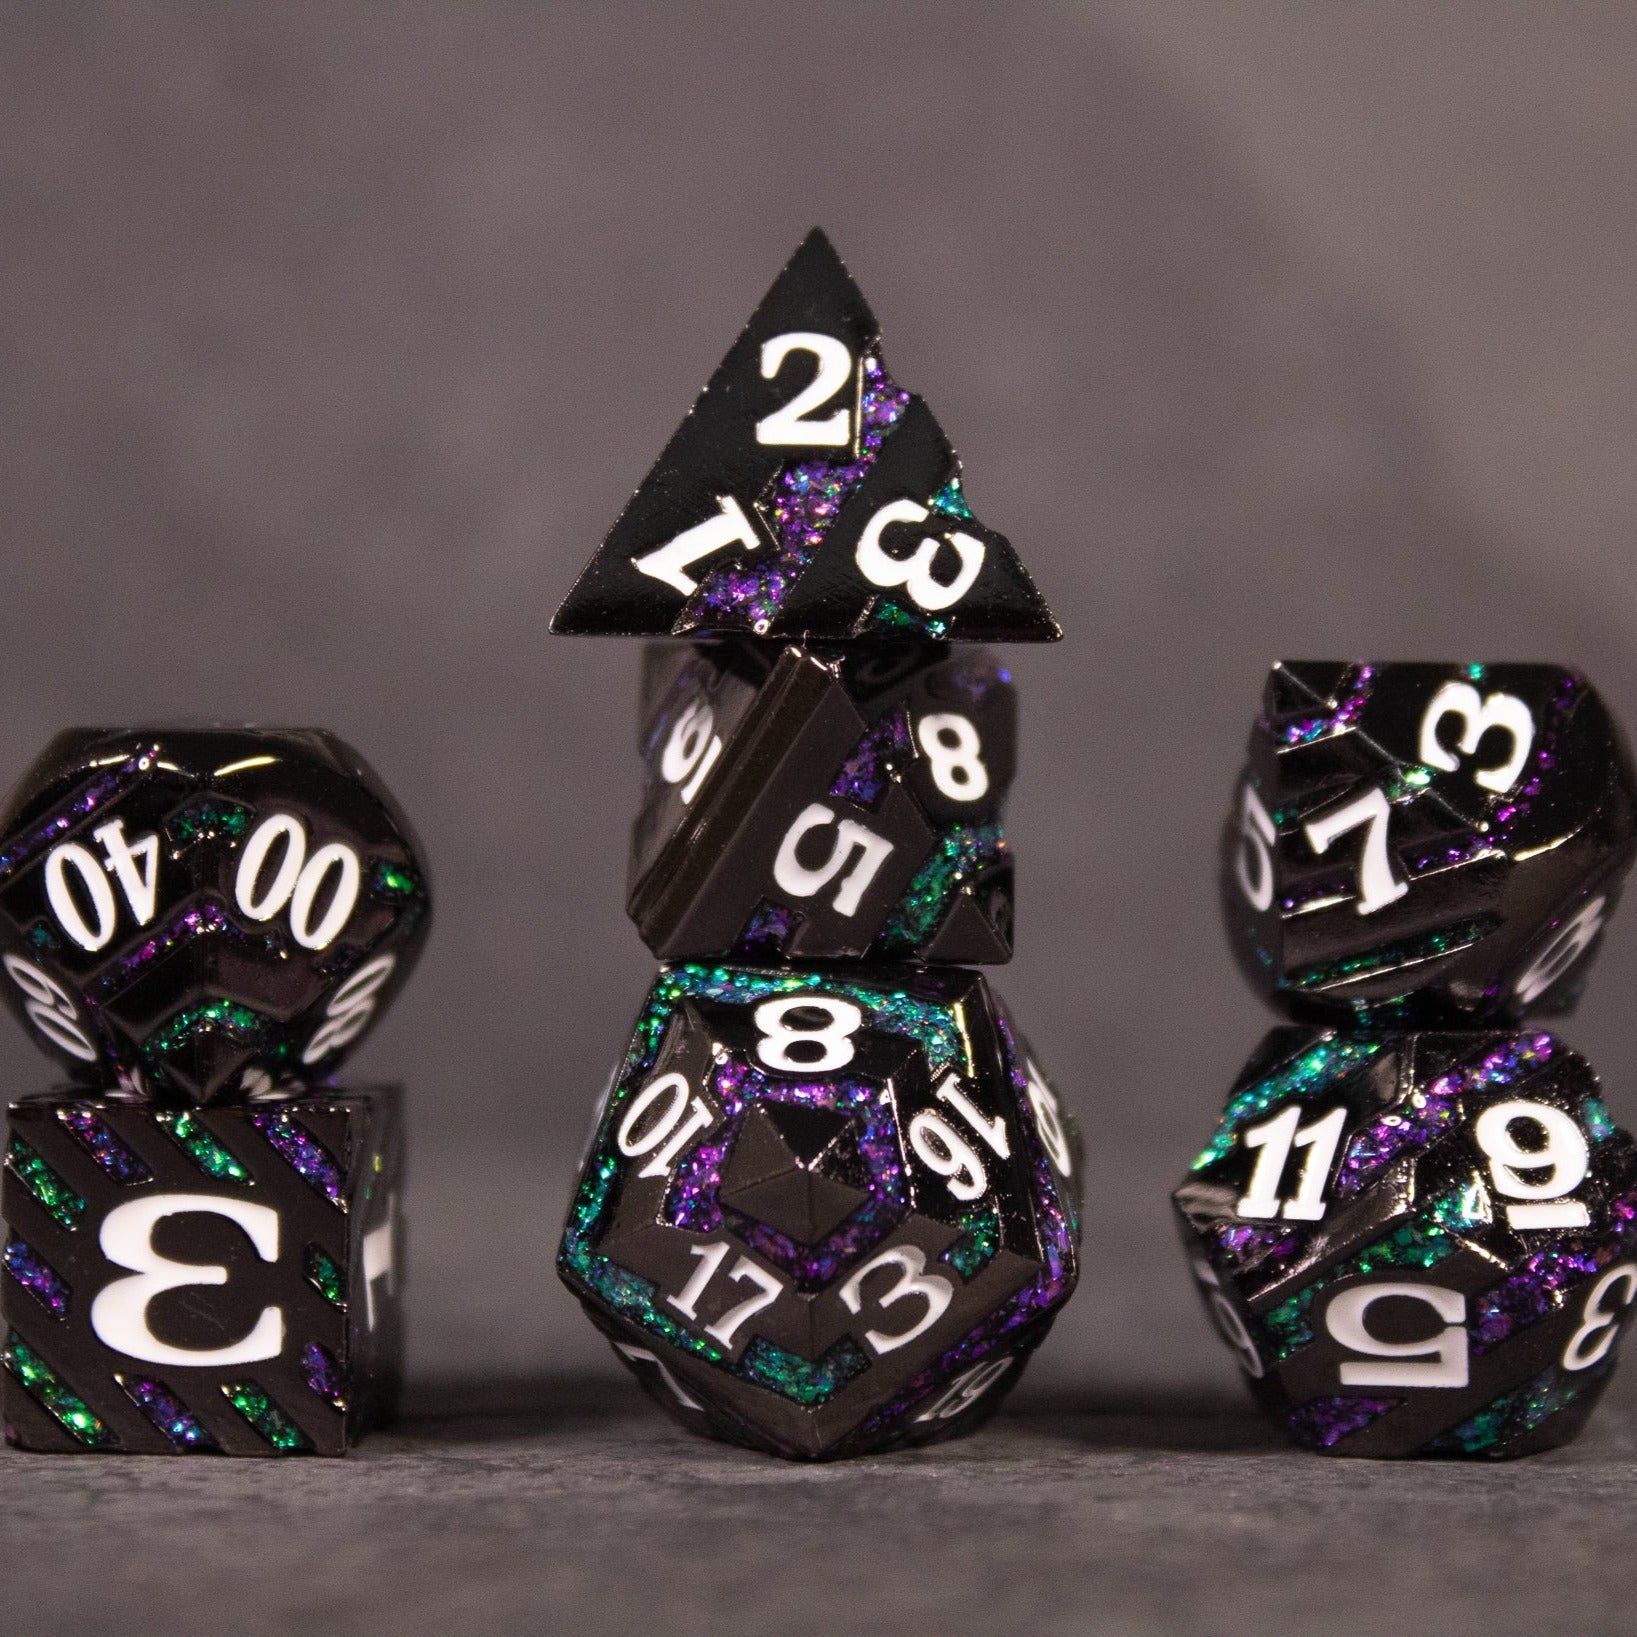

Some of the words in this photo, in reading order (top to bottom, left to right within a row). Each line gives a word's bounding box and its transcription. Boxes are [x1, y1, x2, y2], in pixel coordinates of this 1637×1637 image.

[756, 332, 852, 445] 2
[632, 495, 760, 597] 1
[856, 500, 986, 612] 3
[918, 712, 989, 802] 8
[1420, 680, 1535, 794] 3
[44, 814, 159, 952] 40
[234, 813, 361, 950] 00
[773, 802, 894, 918] 5
[1304, 787, 1408, 916] 7
[754, 997, 861, 1073] 8
[617, 1073, 715, 1179] 10
[909, 1073, 1008, 1201] 16
[1236, 1106, 1348, 1221] 11
[1476, 1101, 1591, 1230] 9
[91, 1194, 285, 1367] 3
[666, 1241, 784, 1350] 17
[839, 1244, 954, 1355] 3
[1325, 1282, 1470, 1388] 5
[1563, 1263, 1637, 1372] 3
